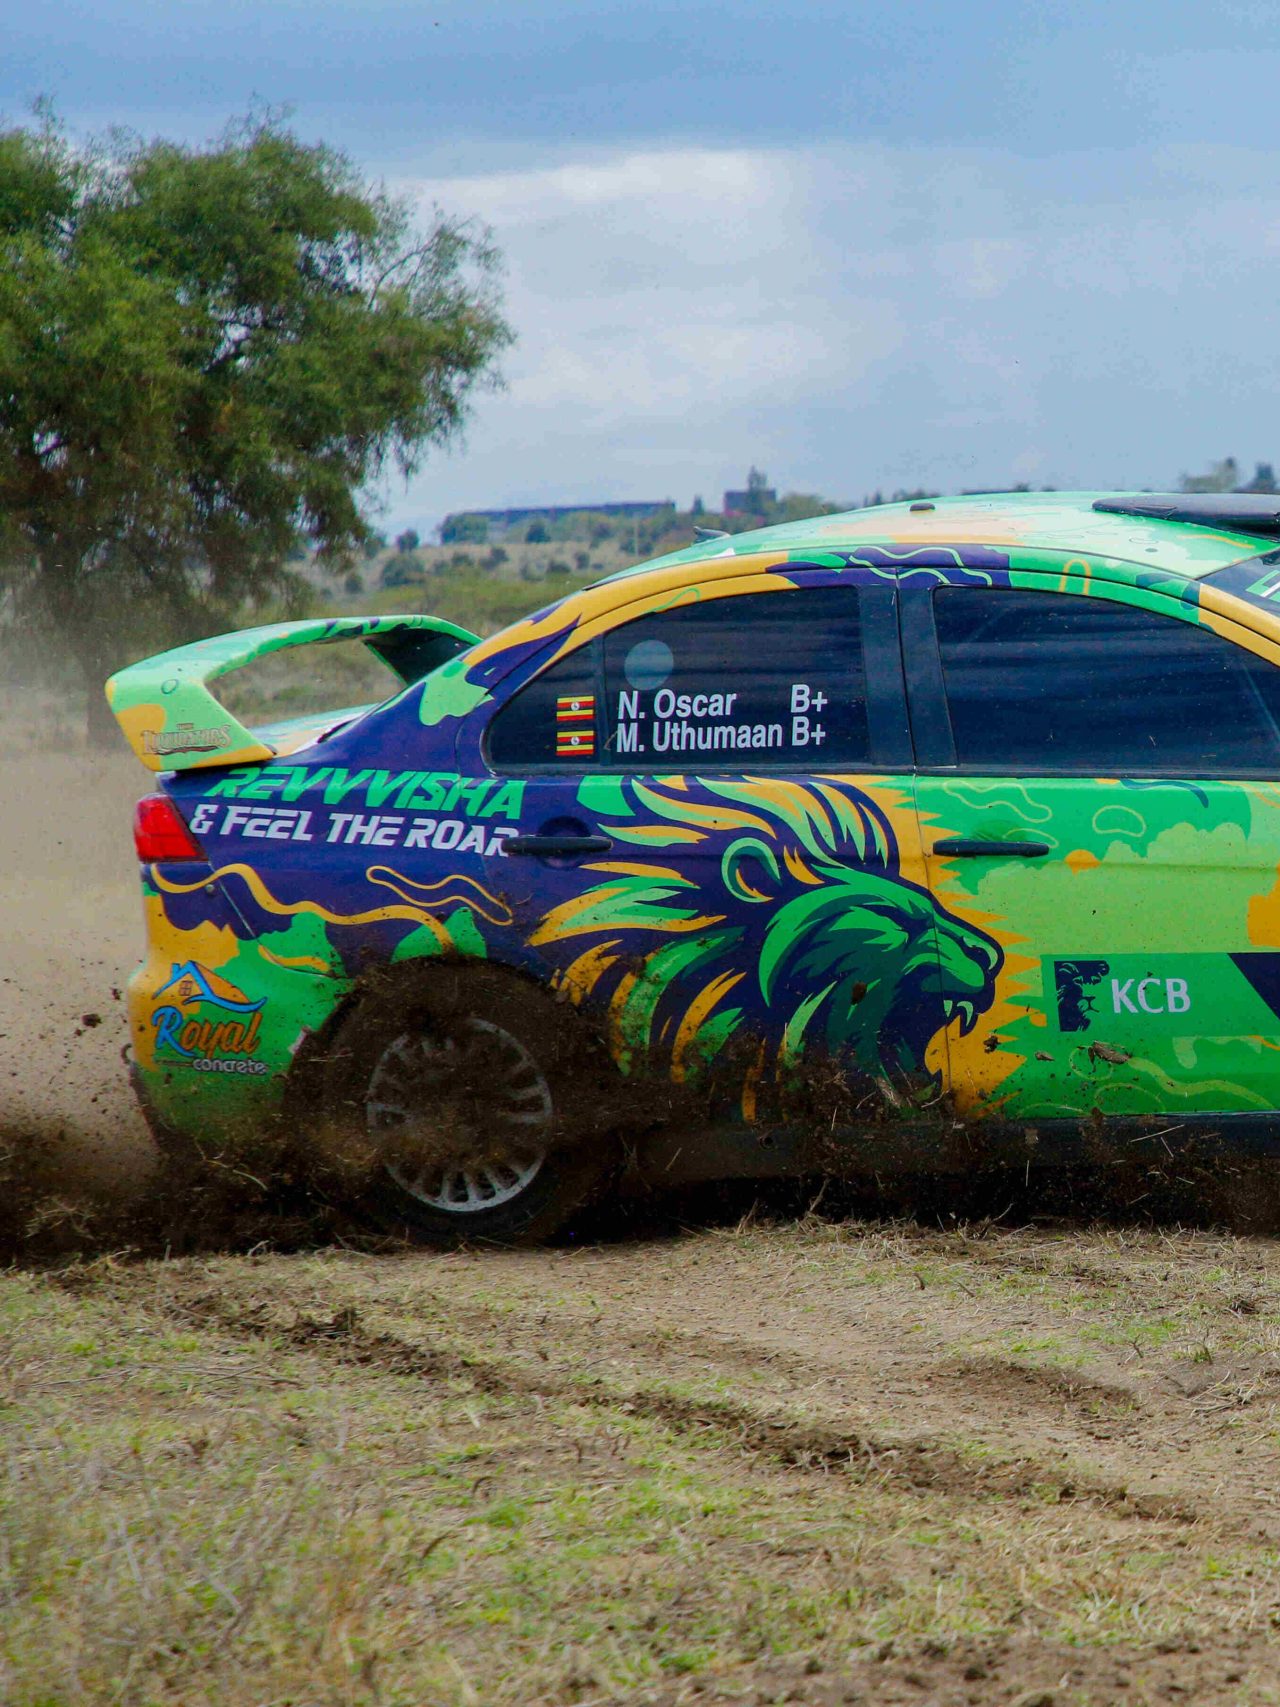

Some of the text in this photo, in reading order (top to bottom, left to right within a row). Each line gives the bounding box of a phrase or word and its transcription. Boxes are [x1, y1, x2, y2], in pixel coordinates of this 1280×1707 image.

[618, 684, 828, 719] N. Oscar B+
[616, 716, 826, 753] M. Uthumaan B+
[203, 765, 528, 820] REVVVISHA
[189, 803, 519, 858] & FEEL THE ROAR
[1111, 976, 1192, 1014] KCB
[151, 1004, 263, 1060] Royal
[192, 1057, 269, 1075] concrete
